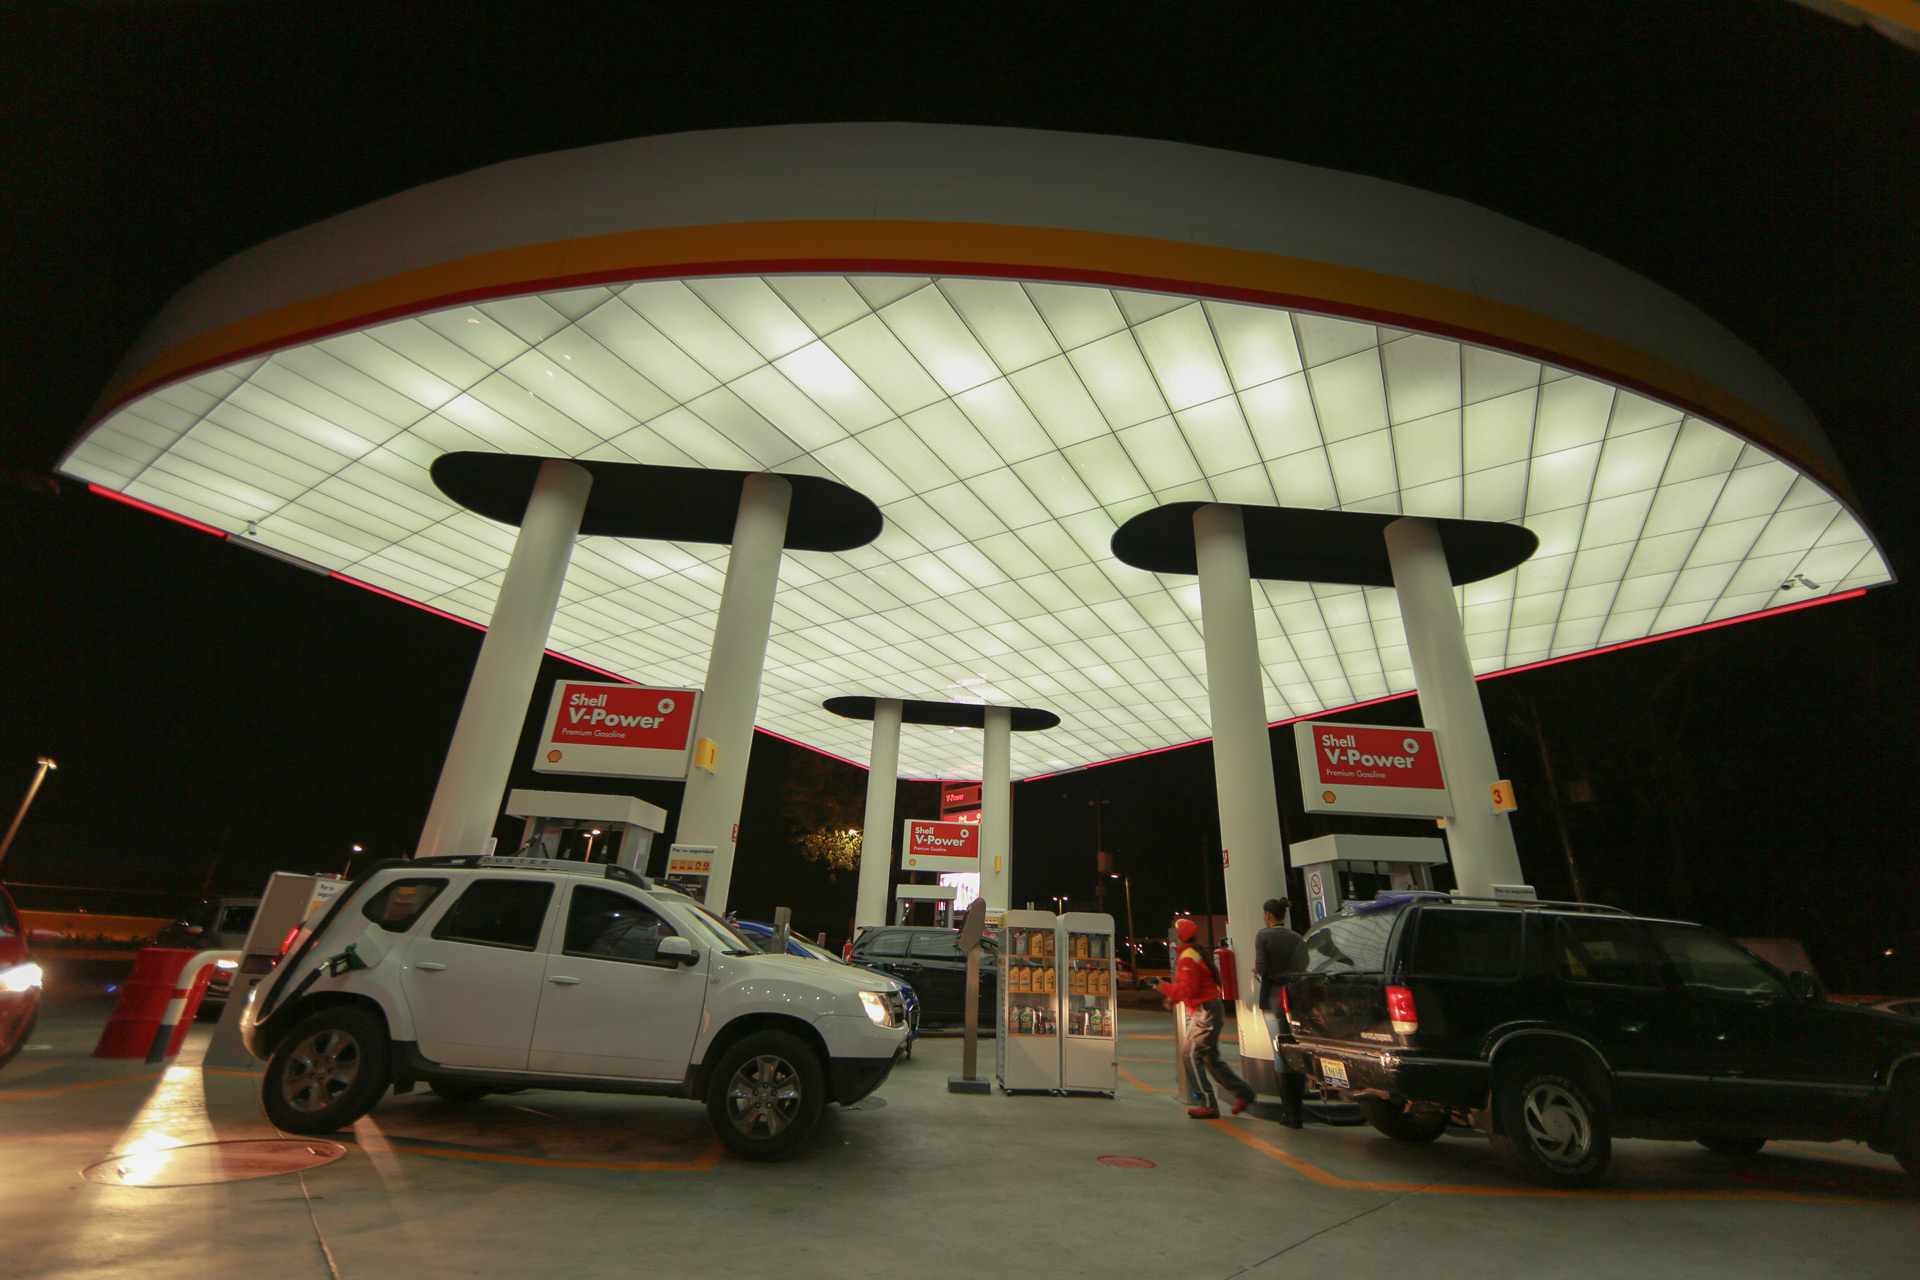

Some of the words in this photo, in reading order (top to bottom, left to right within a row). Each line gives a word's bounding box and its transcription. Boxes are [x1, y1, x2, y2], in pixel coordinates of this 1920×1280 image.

[569, 693, 608, 707] Shell
[568, 706, 665, 729] V-Power
[561, 728, 592, 737] Premium
[594, 729, 626, 738] Gasoline
[1321, 734, 1356, 748] Shell
[1323, 748, 1415, 769] V-Power
[1326, 768, 1355, 777] Premium
[1356, 770, 1386, 779] Gasoline
[945, 794, 965, 803] V-Power
[1493, 789, 1503, 805] 3
[915, 826, 934, 835] Shell
[915, 834, 965, 847] V-Power
[483, 857, 549, 866] DUSTER
